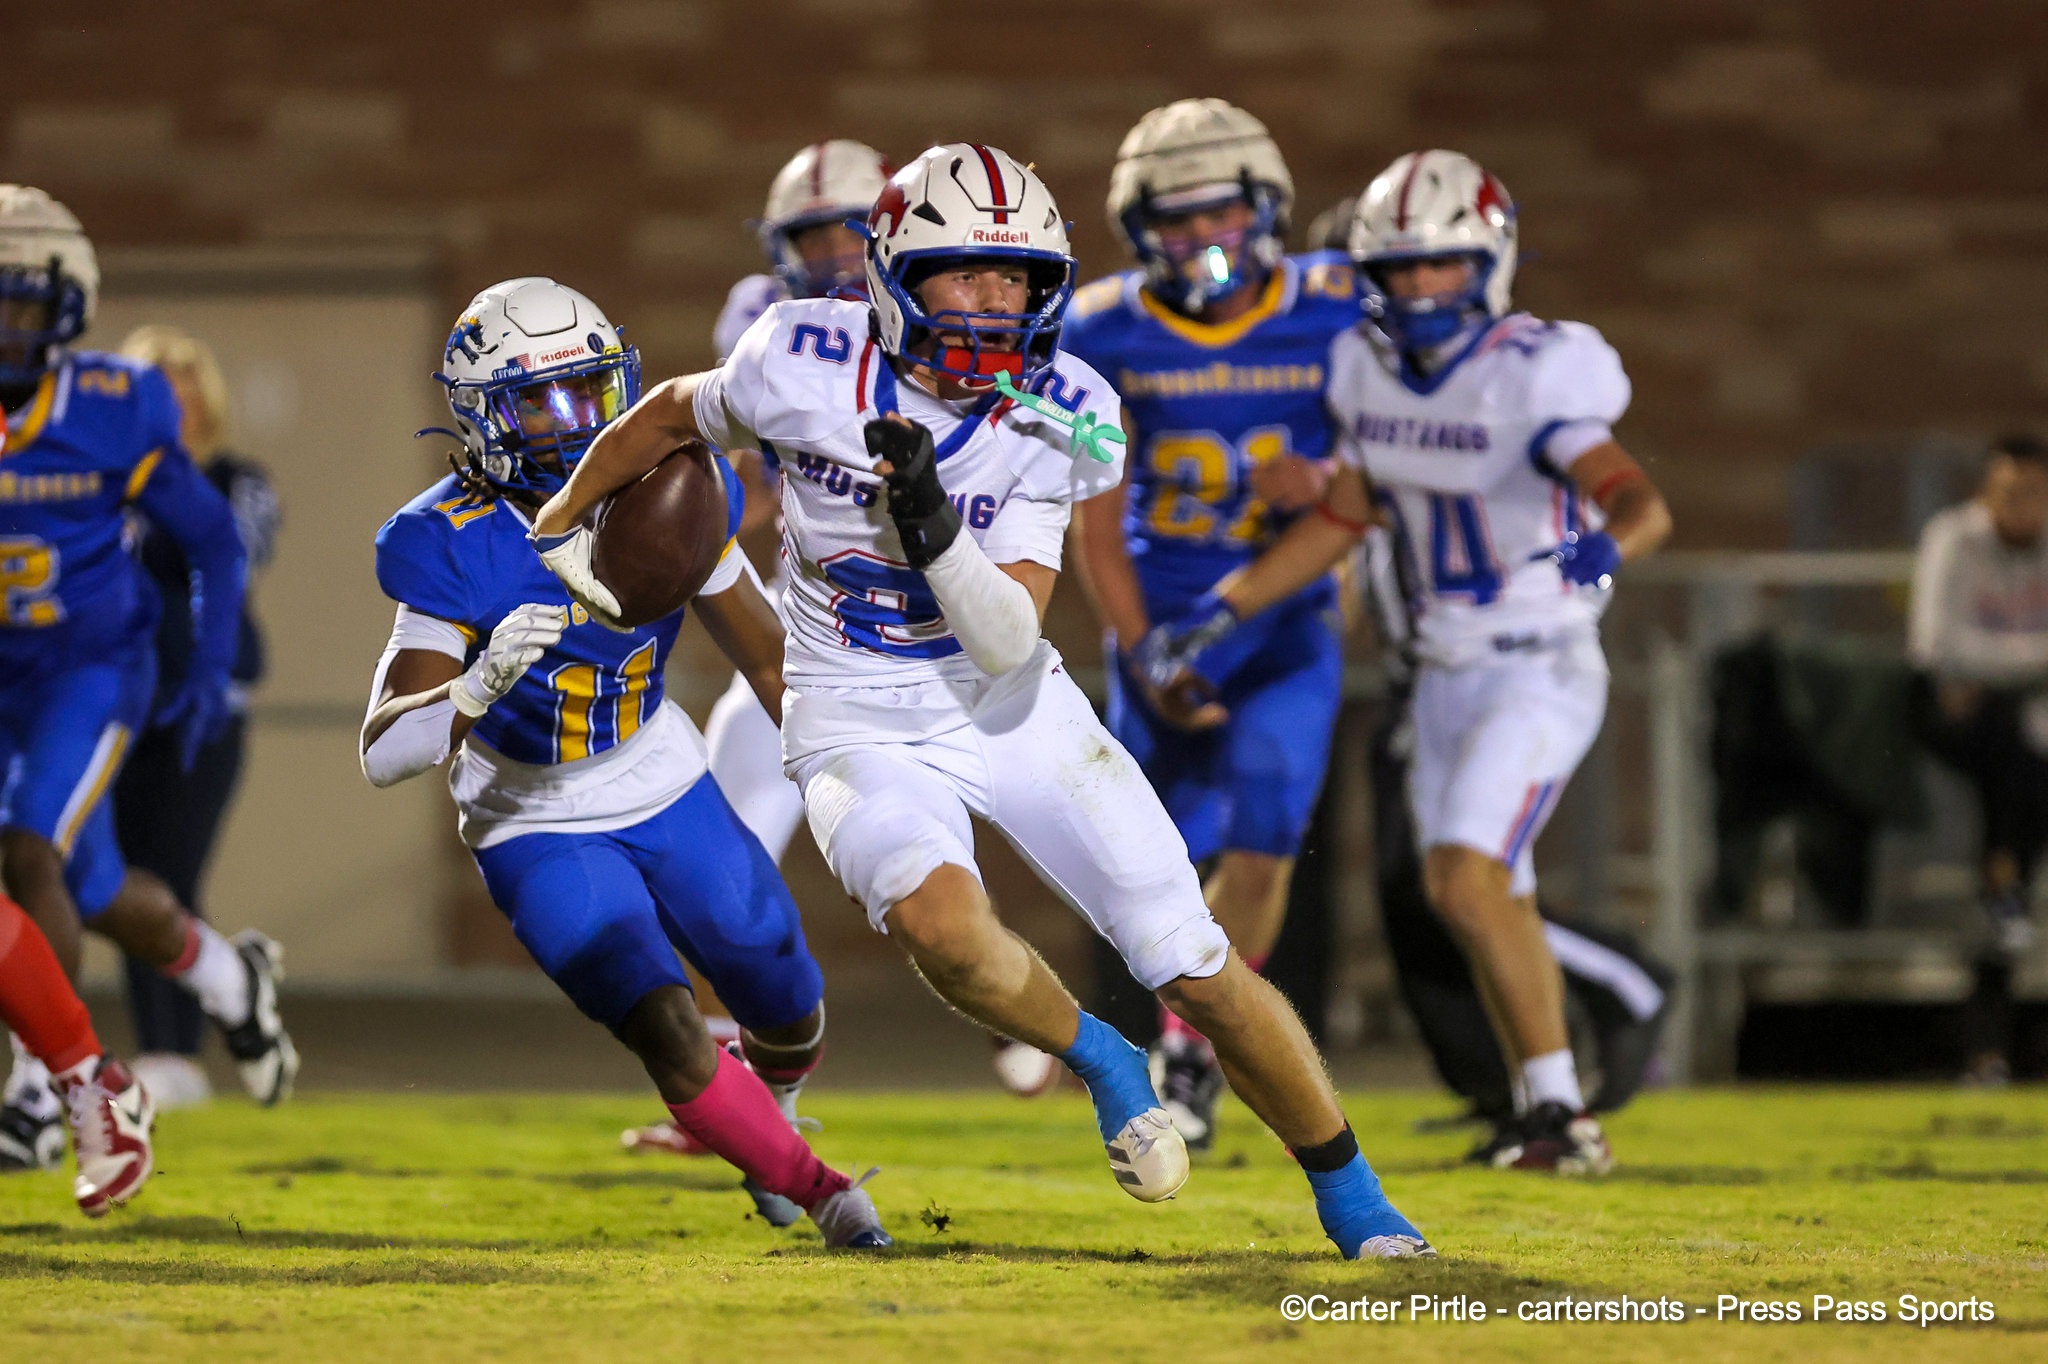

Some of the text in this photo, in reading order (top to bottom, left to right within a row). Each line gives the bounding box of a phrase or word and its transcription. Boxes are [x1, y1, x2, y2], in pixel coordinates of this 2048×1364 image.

[973, 229, 1029, 244] Riddell
[540, 345, 586, 365] Riddell
[787, 321, 854, 365] 2
[1026, 366, 1091, 414] 2
[432, 496, 497, 531] 11
[547, 635, 658, 765] 11
